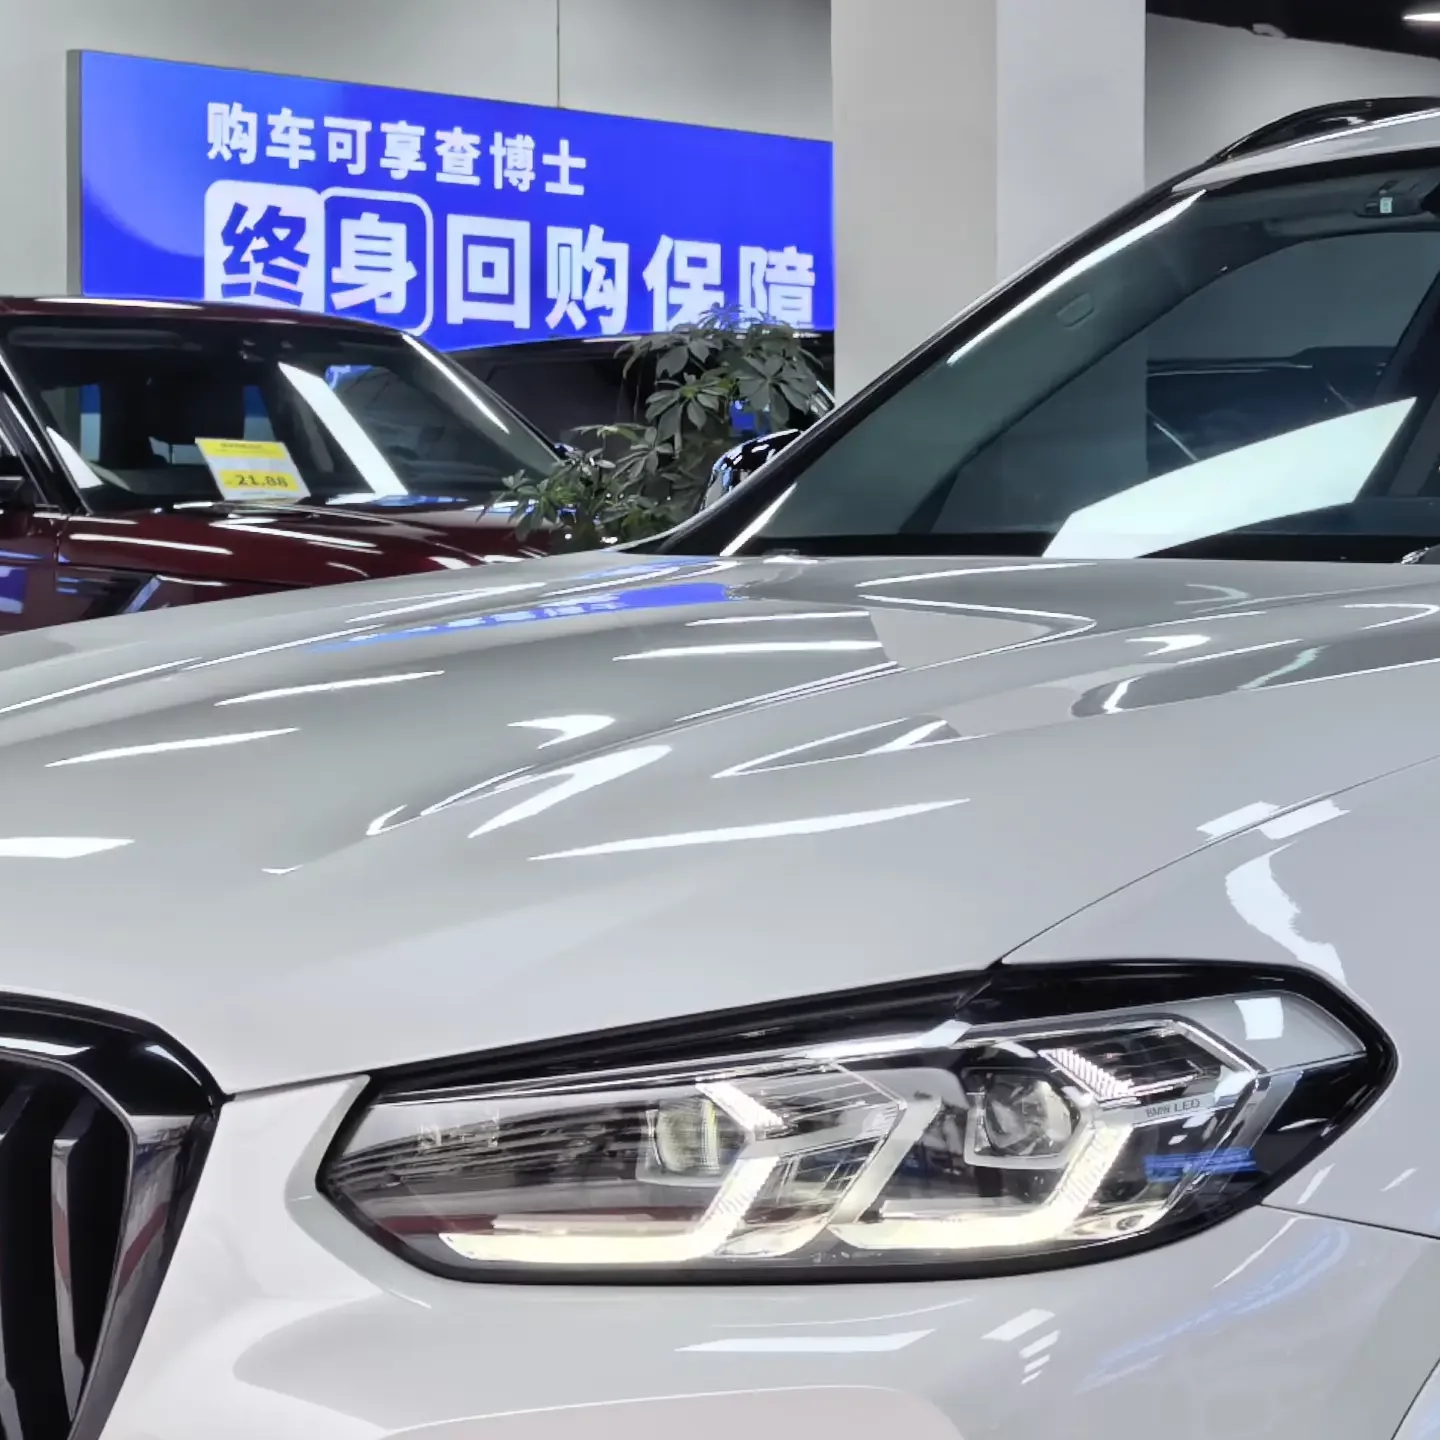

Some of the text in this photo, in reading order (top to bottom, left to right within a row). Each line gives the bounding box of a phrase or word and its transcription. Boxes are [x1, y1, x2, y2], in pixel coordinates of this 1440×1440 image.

[206, 101, 587, 196] 购车可享查博士
[220, 202, 816, 335] 终身回购保障
